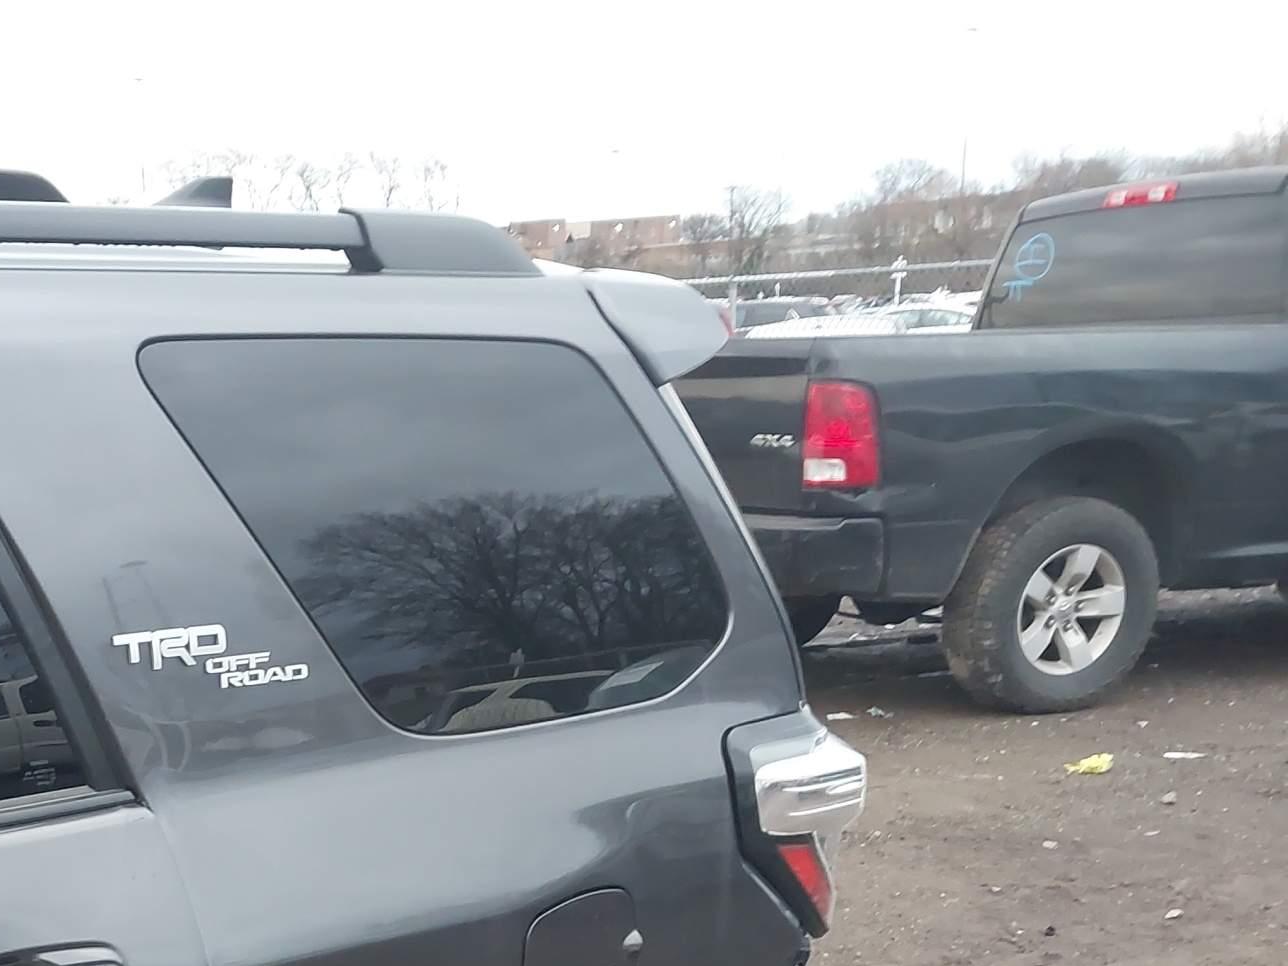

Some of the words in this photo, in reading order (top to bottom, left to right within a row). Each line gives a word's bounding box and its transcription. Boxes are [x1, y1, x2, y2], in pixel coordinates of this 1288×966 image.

[112, 624, 227, 670] TRD
[206, 651, 271, 674] OFF
[220, 663, 309, 689] ROAD
